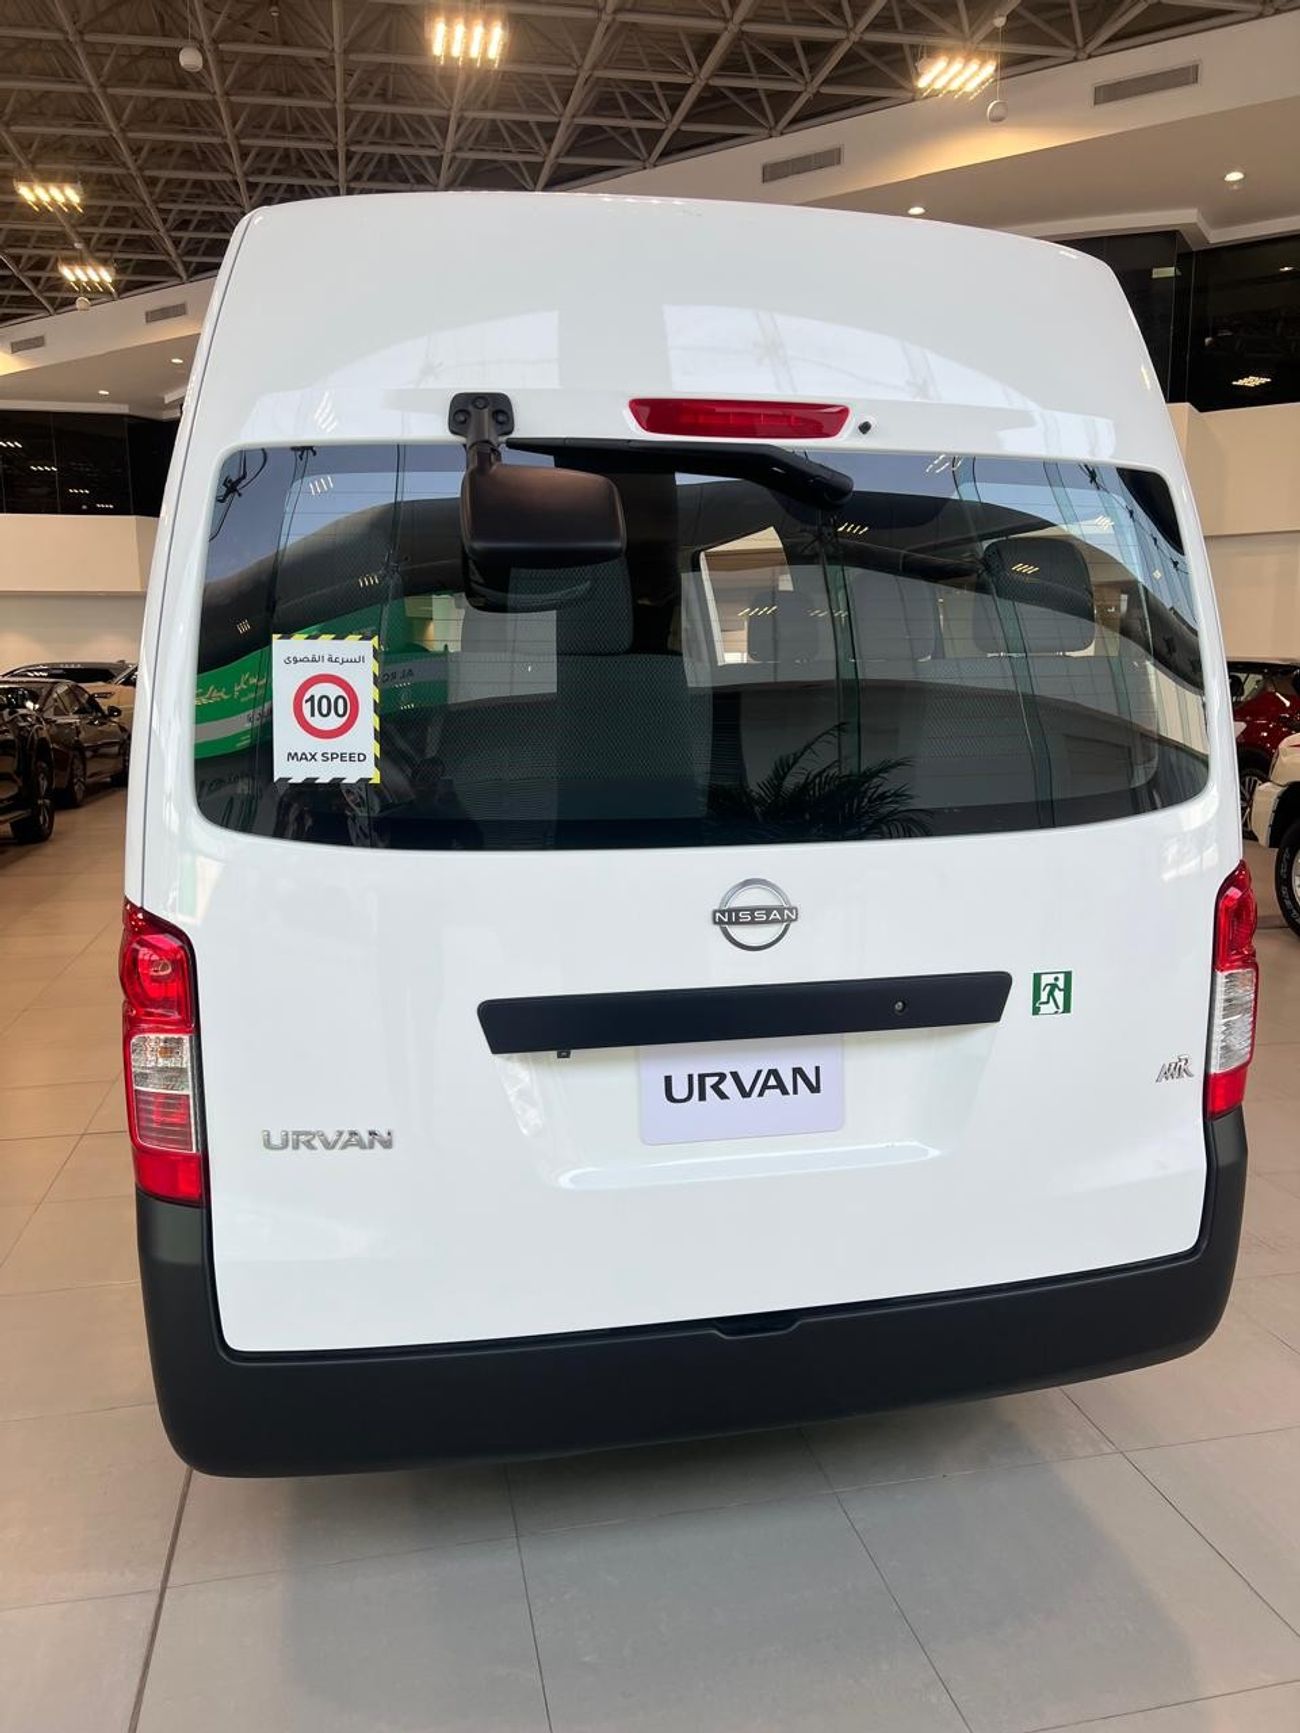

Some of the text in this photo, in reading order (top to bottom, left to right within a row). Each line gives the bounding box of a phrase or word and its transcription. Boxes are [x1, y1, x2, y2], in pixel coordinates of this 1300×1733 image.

[327, 654, 366, 666] السرعة
[304, 694, 349, 718] 100
[286, 751, 367, 763] MAX SPEED
[715, 908, 797, 923] NISSAN
[663, 1066, 821, 1104] URVAN
[262, 1130, 393, 1151] URVAN
